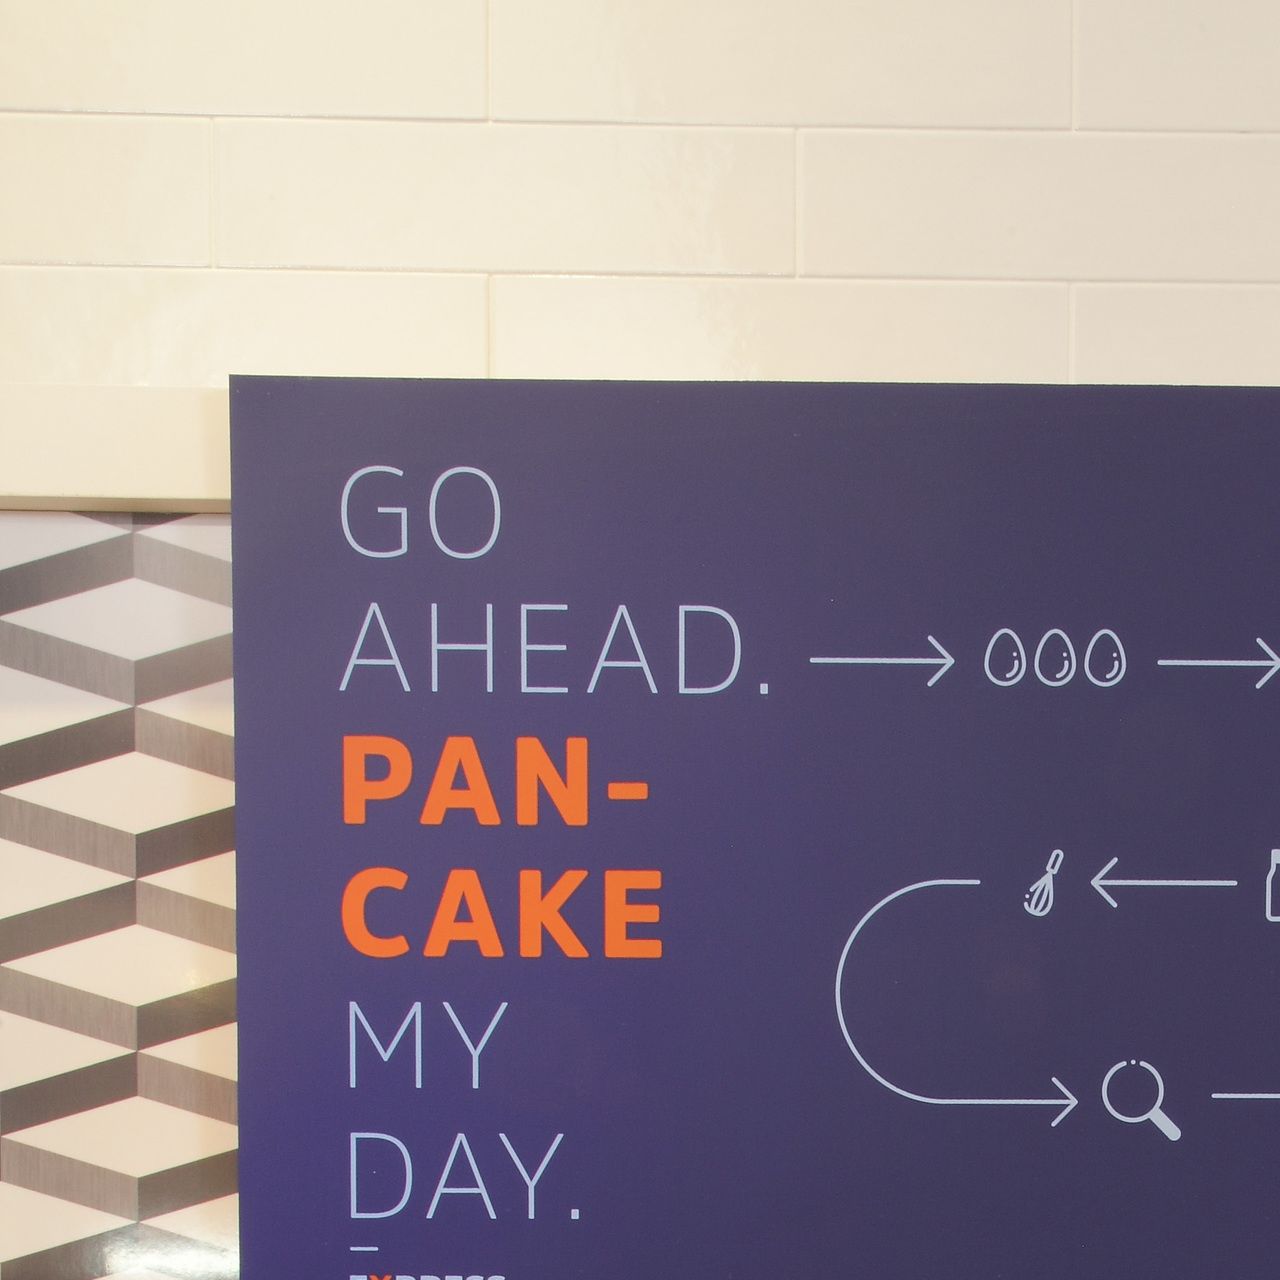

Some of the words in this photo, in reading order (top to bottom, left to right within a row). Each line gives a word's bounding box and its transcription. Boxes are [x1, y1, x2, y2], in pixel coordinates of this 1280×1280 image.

[340, 464, 502, 560] GO
[338, 601, 770, 695] AHEAD.
[341, 734, 649, 826] PAN-
[340, 867, 663, 959] CAKE
[348, 1001, 508, 1090] MY
[349, 1131, 582, 1220] DAY.
